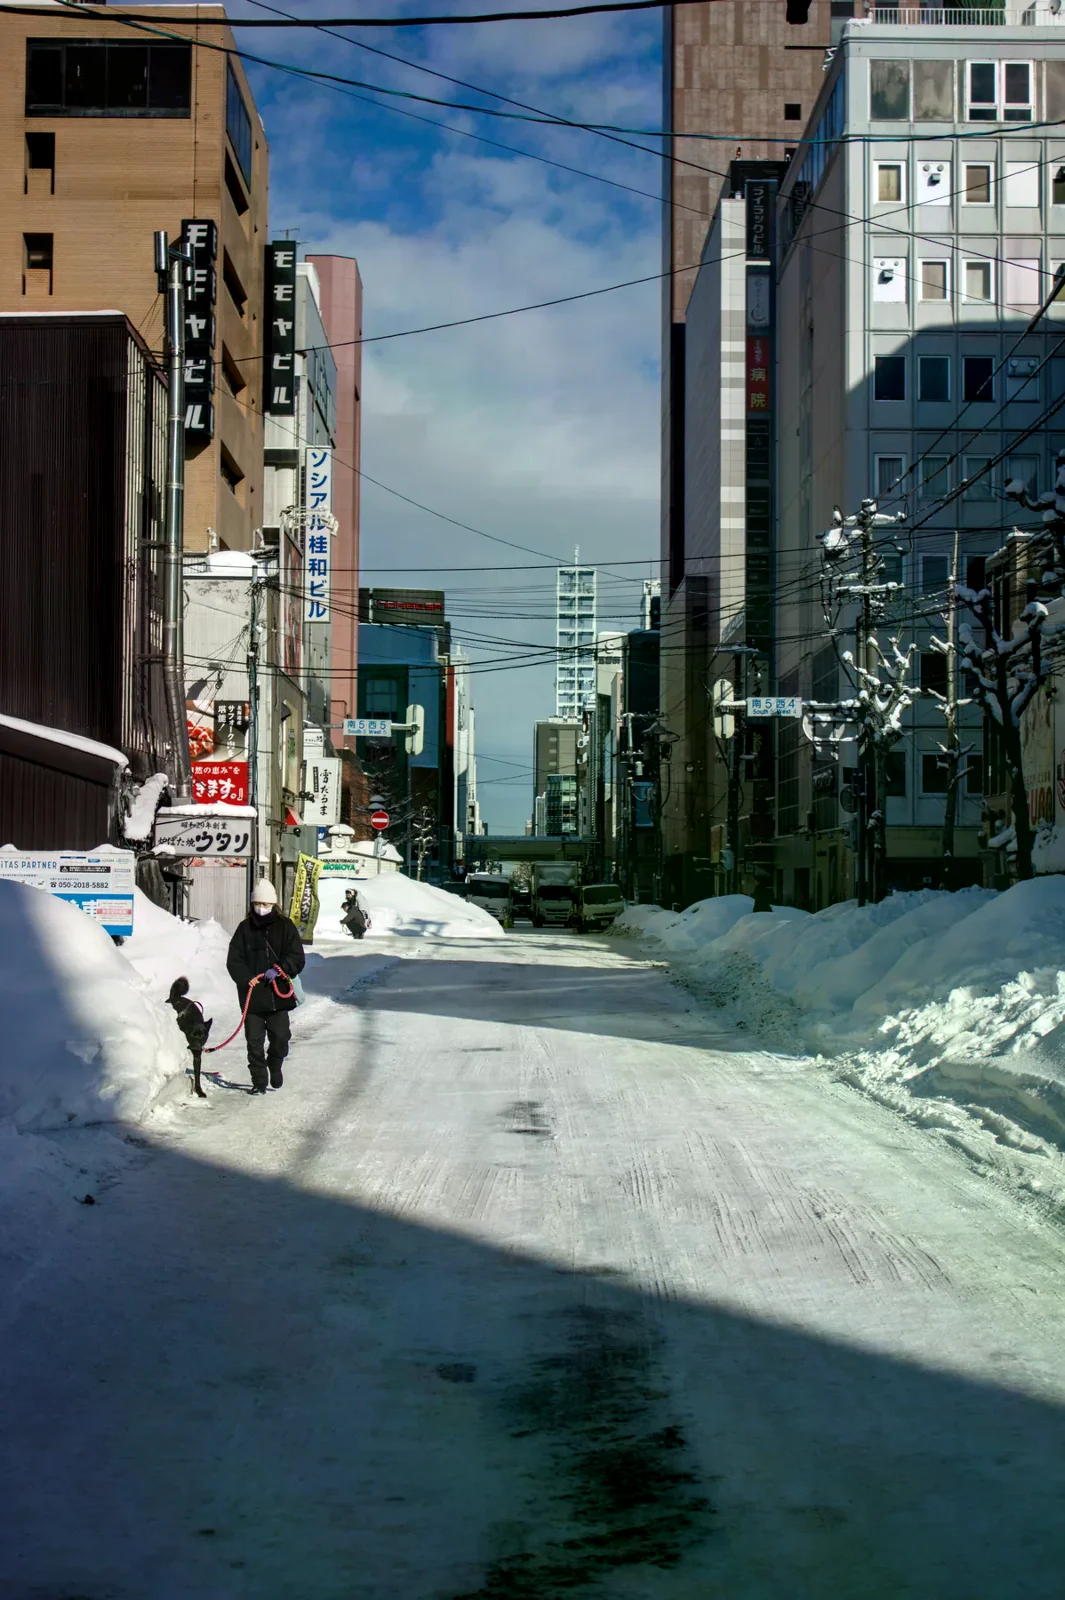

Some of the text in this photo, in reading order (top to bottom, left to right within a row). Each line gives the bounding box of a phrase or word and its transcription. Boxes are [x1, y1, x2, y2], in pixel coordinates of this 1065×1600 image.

[184, 224, 208, 429] モモヤビル
[273, 251, 294, 404] モモヤビル
[308, 451, 328, 619] ソシアル桂和ビル
[192, 778, 244, 801] きます。』
[181, 821, 228, 830] 昭和29年創業
[195, 831, 249, 852] ウタリ
[21, 860, 57, 869] PARTNER
[322, 863, 356, 871] MOMOYA
[58, 881, 109, 889] 050-2018-5882
